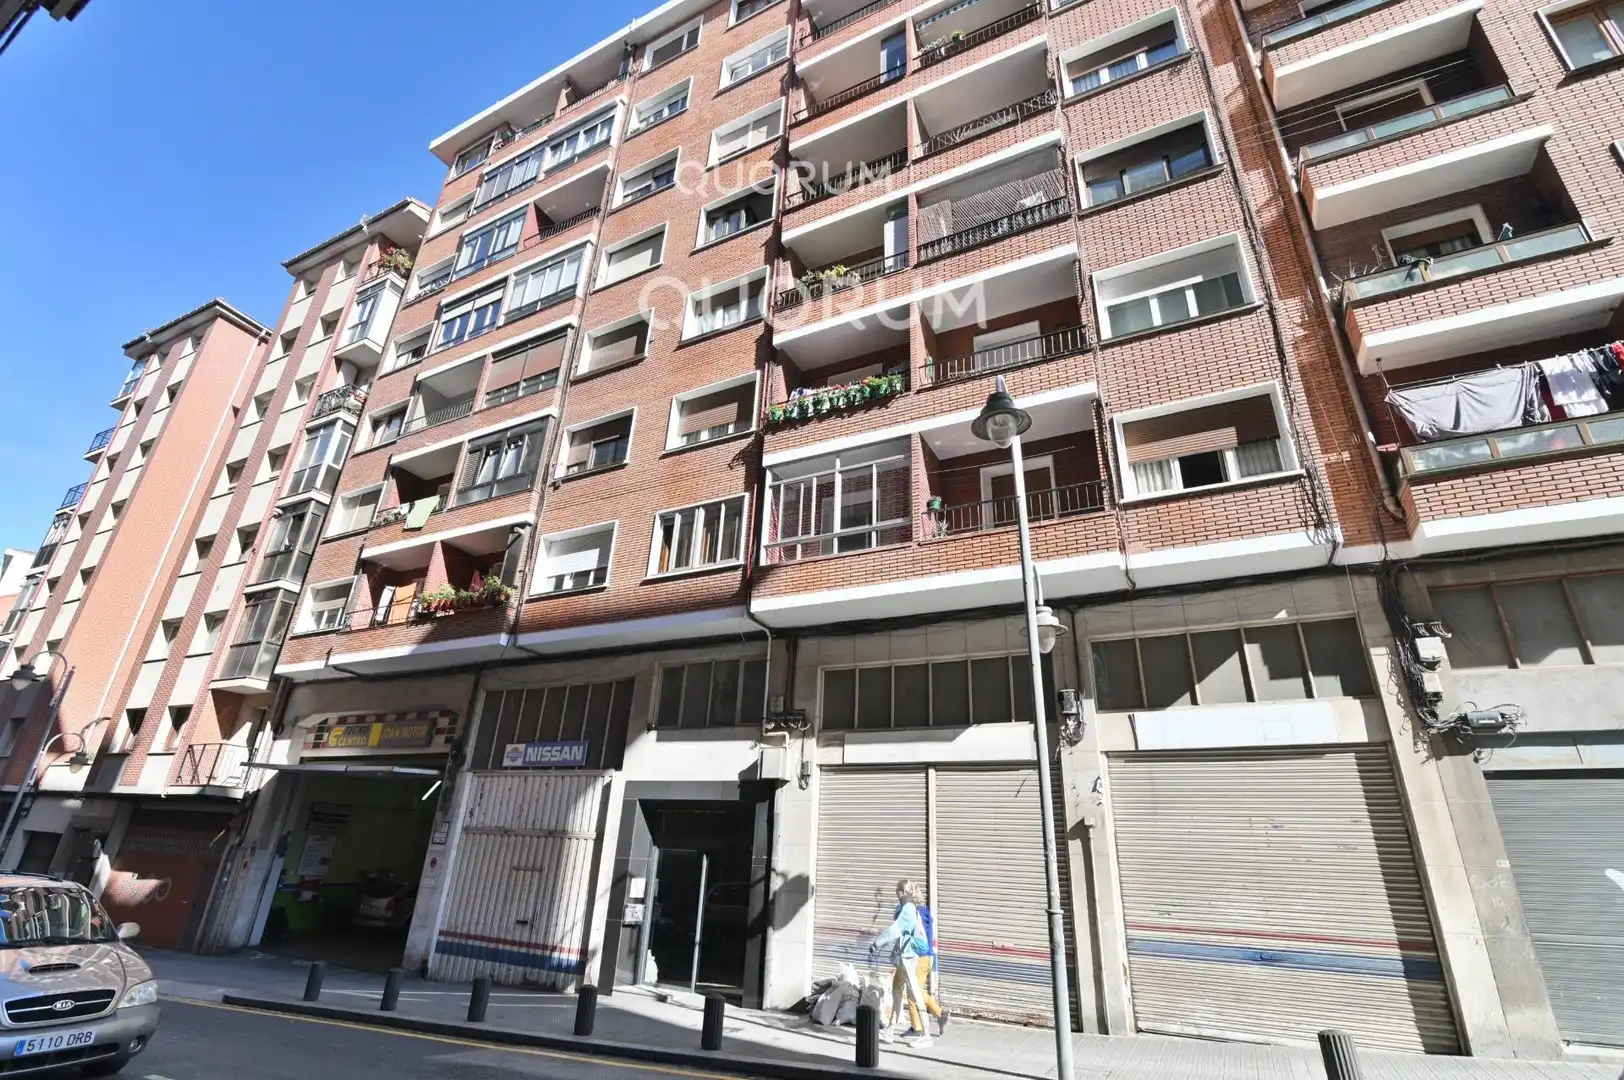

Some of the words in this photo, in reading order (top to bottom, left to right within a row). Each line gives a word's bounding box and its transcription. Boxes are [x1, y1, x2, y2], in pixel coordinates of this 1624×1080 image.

[400, 725, 428, 738] MOTOR
[337, 736, 367, 747] CENTRO
[525, 745, 584, 762] NISSAN
[55, 1002, 72, 1010] KIA
[26, 1036, 63, 1052] 5110
[66, 1031, 93, 1046] DRB
